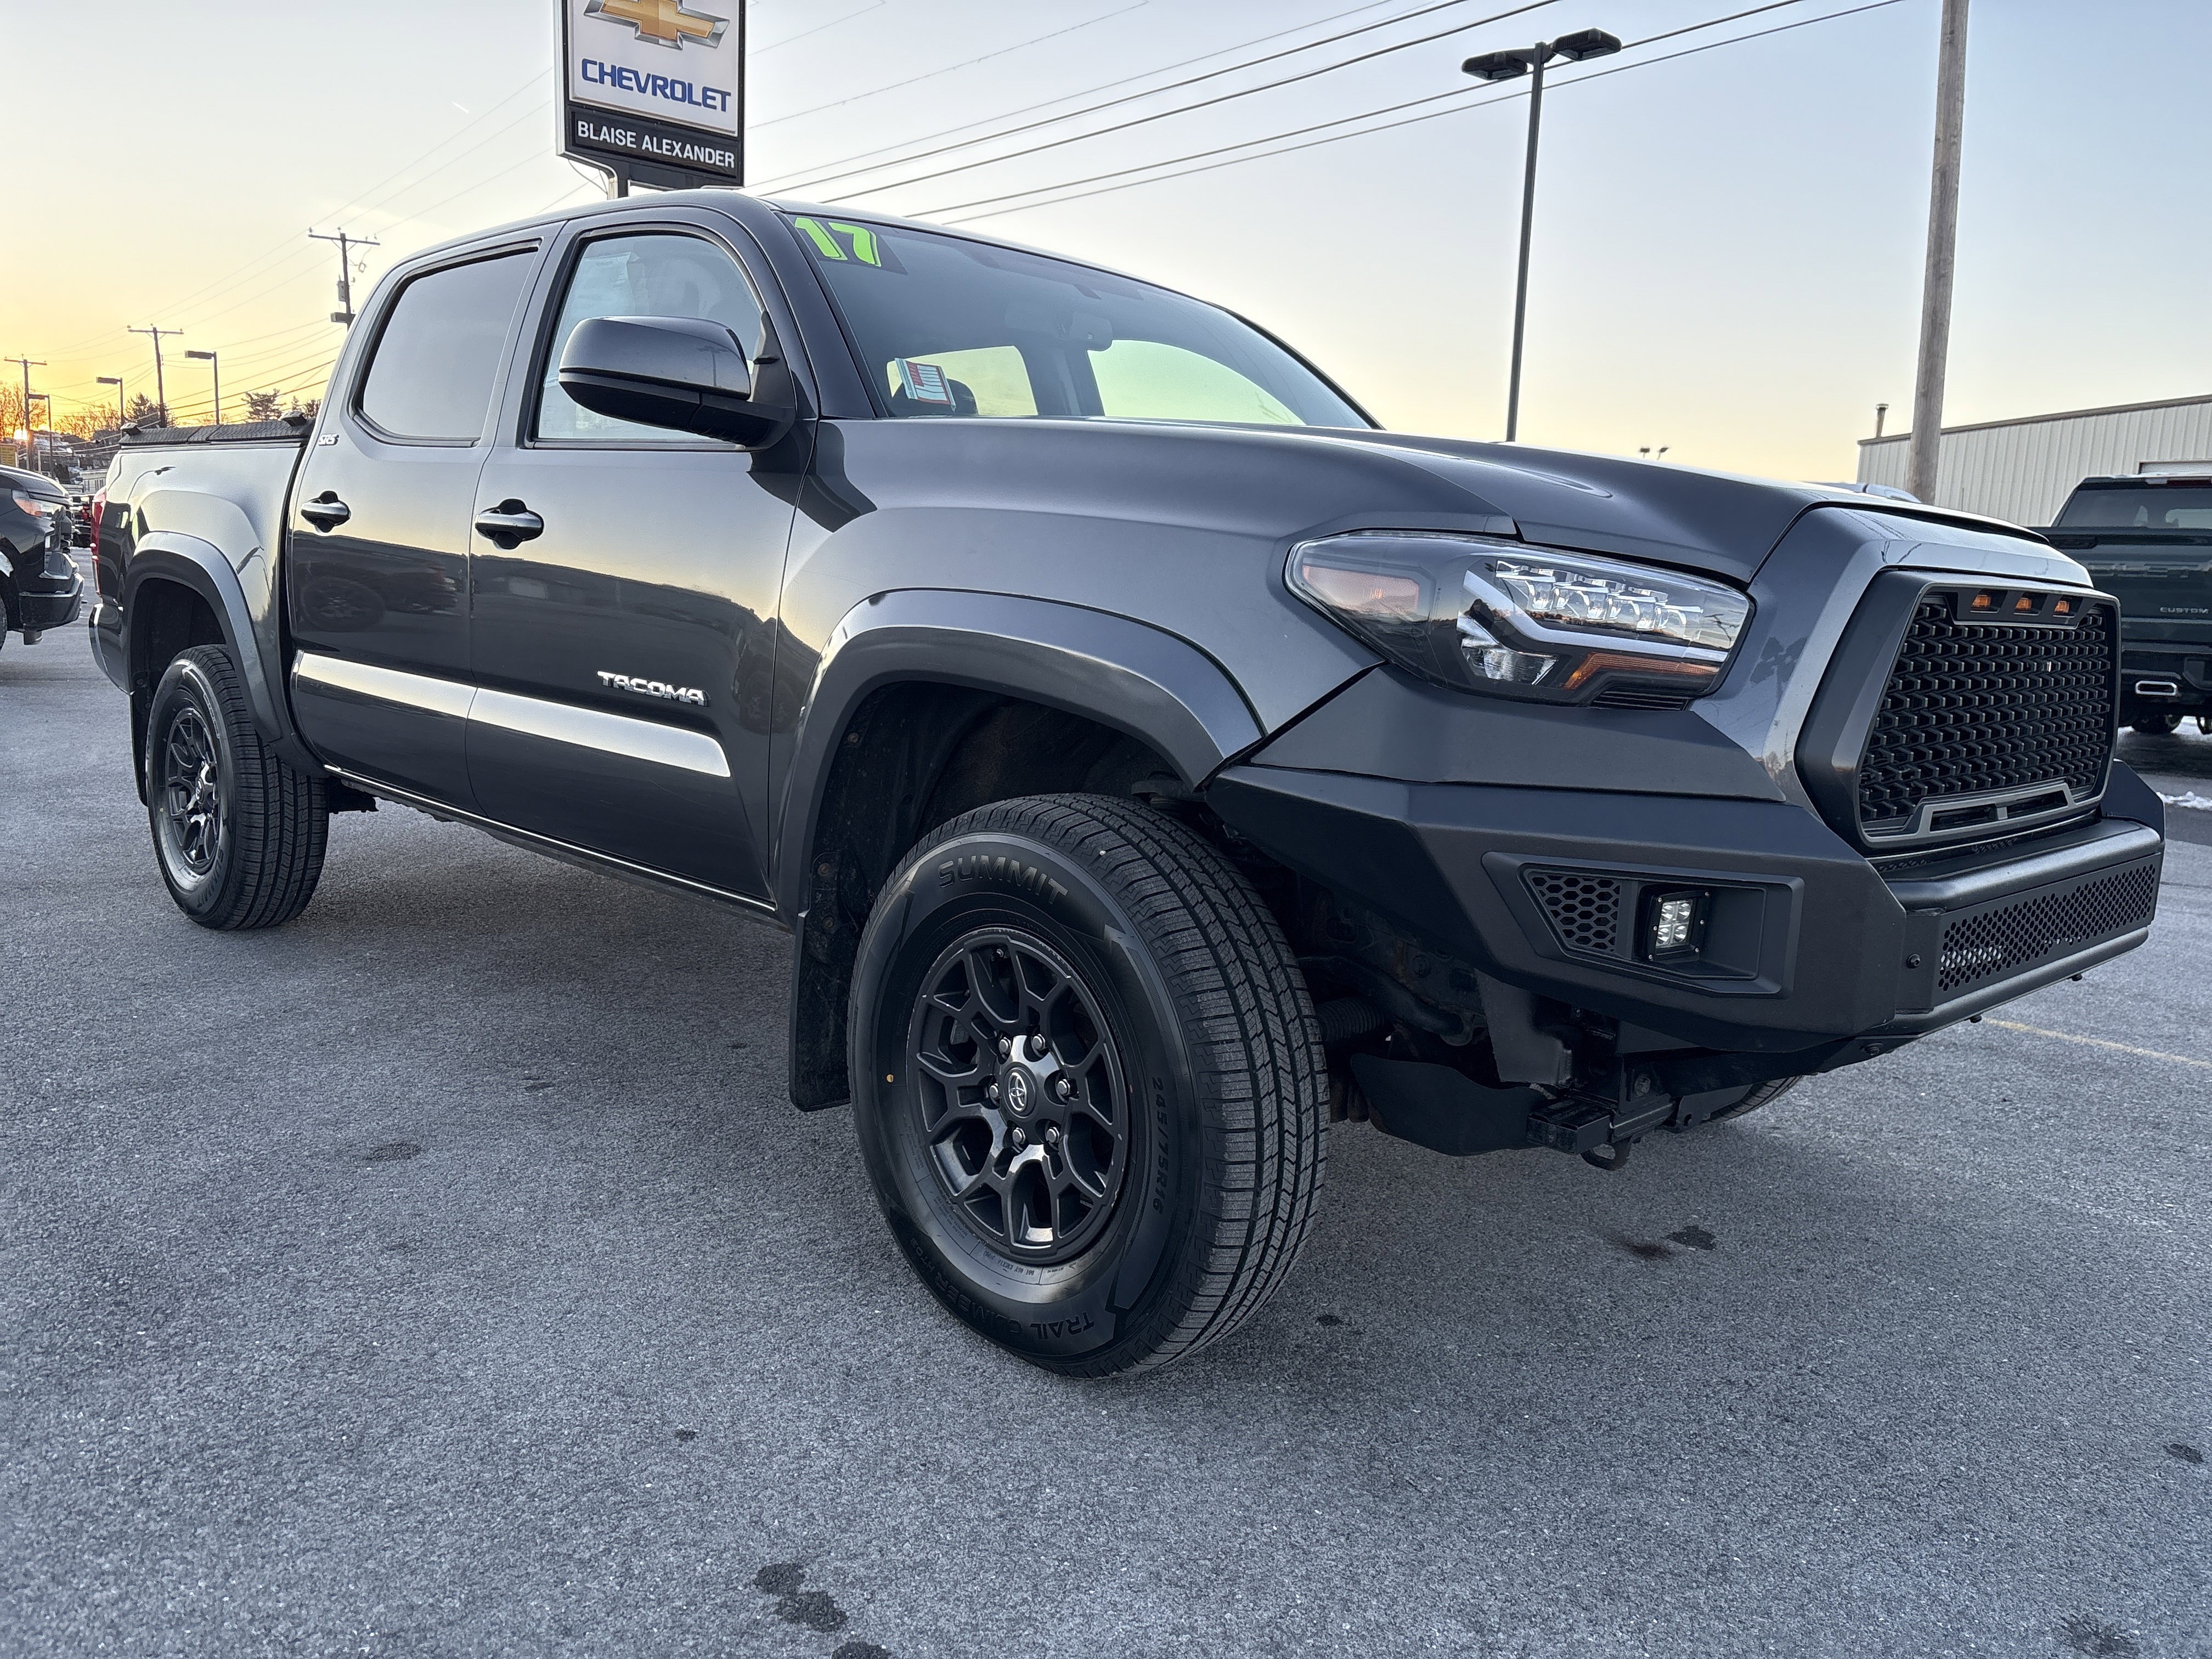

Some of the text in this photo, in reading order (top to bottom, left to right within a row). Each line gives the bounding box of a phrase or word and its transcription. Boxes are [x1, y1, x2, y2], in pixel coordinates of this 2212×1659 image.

[582, 58, 731, 112] CHEVROLET
[577, 120, 735, 168] BLAISE ALEXANDER
[795, 217, 882, 267] 17
[2160, 606, 2209, 614] CUSTOM
[596, 670, 711, 707] TACOMA
[938, 855, 1069, 905] SUMMIT
[1152, 1076, 1169, 1215] 245/75R16
[934, 1272, 1023, 1334] CLIMBER
[1030, 1312, 1095, 1339] TRAIL
